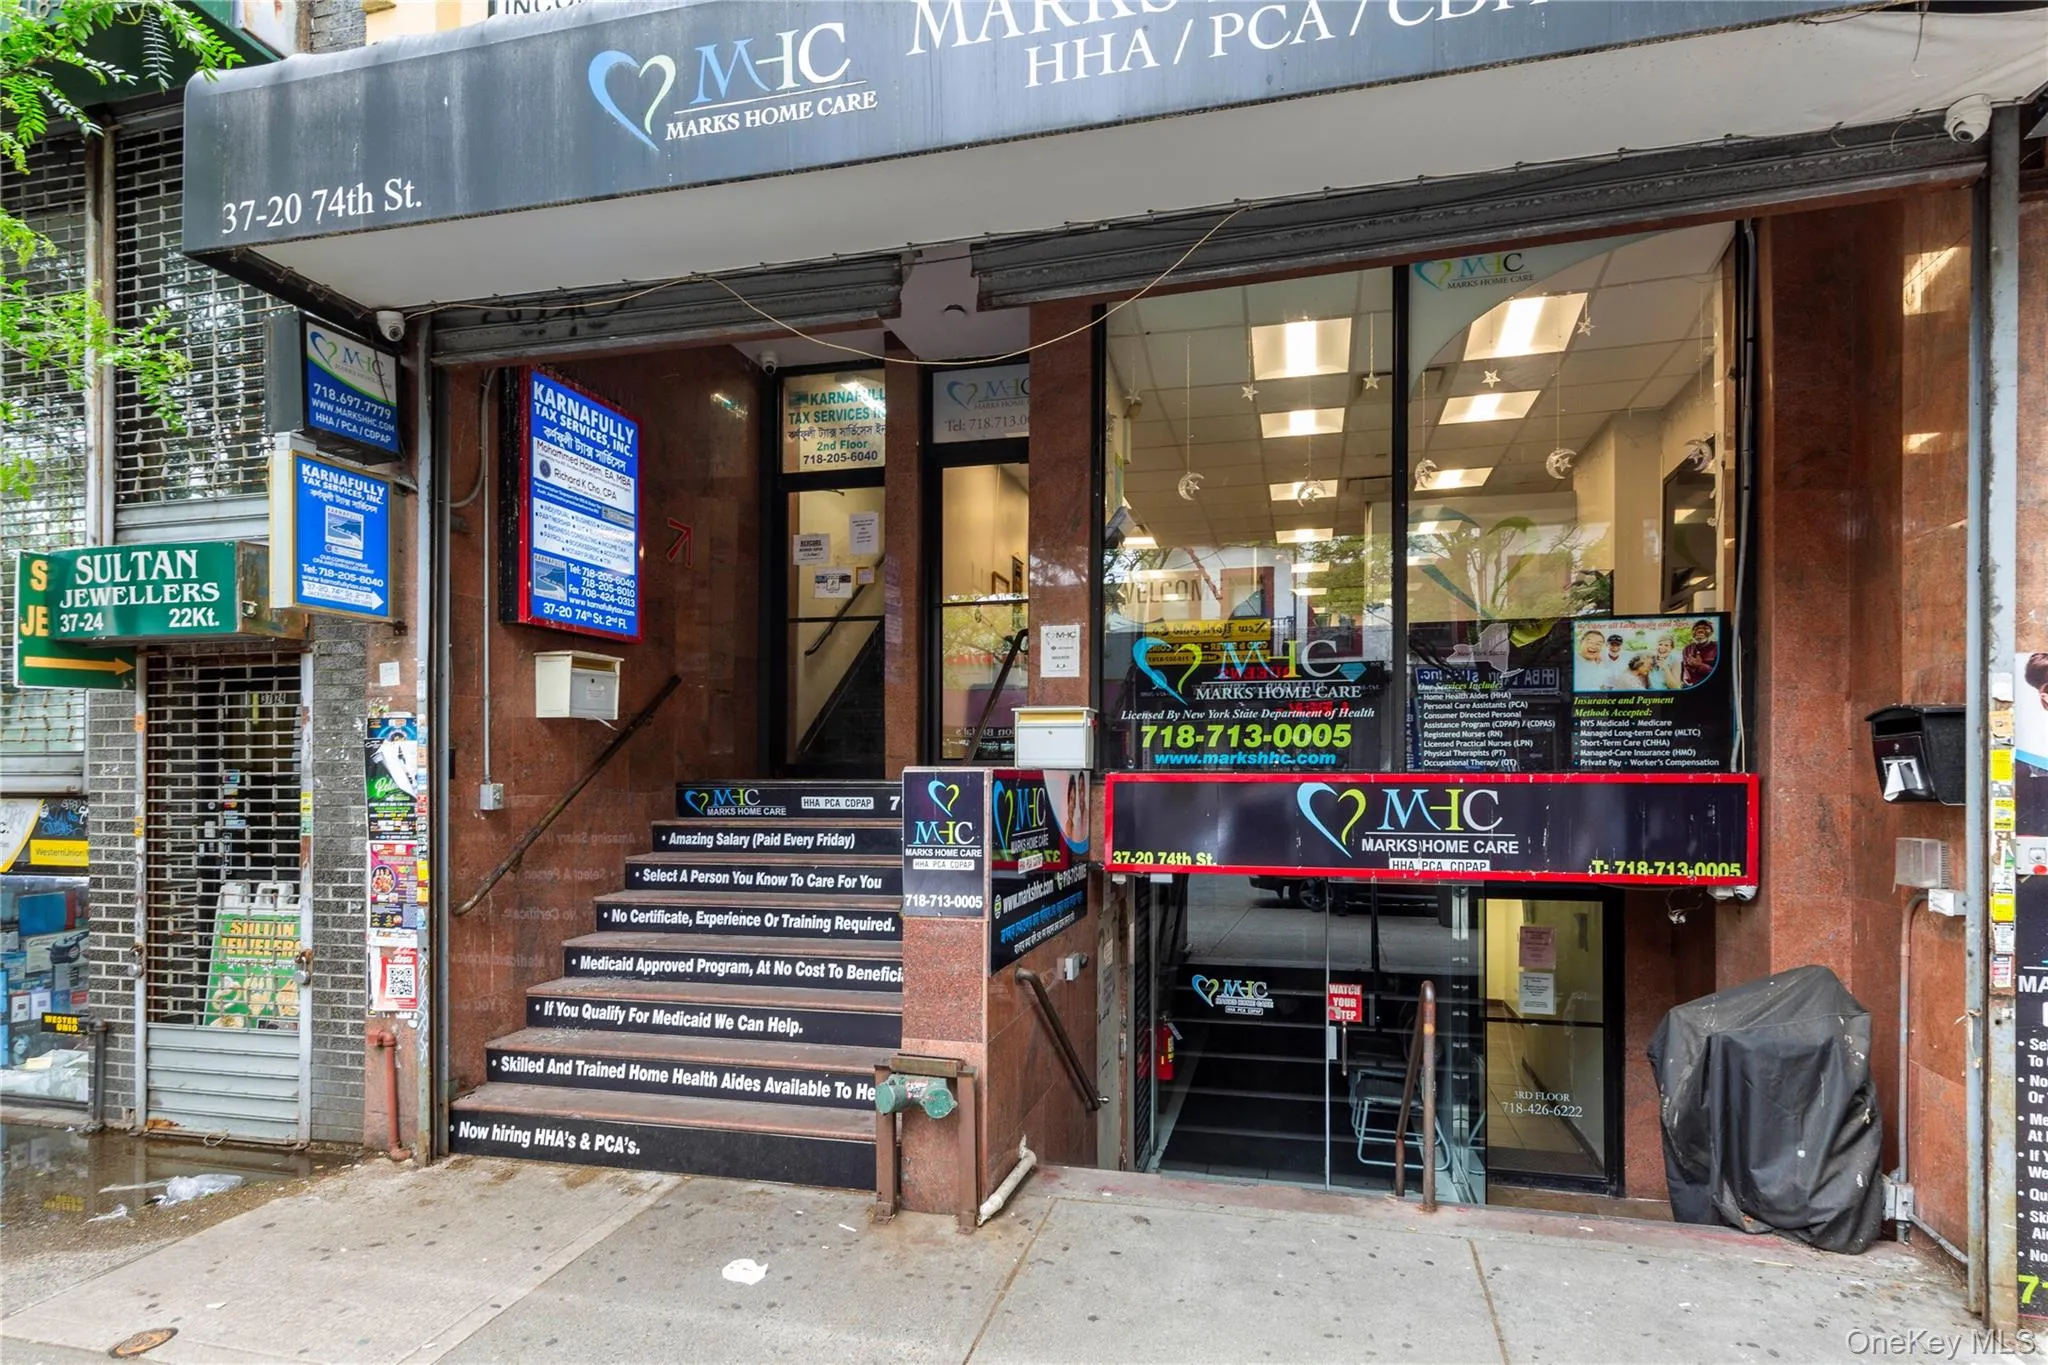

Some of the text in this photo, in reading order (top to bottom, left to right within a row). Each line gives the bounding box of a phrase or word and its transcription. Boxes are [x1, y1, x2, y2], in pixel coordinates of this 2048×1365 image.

[1024, 4, 1335, 88] HHA PCA
[665, 90, 879, 140] MARKS HOME CARE
[221, 179, 423, 236] 37-20 74th St.
[1447, 273, 1535, 289] MARKS HOME CARE
[313, 382, 392, 420] 718.697.7779
[533, 380, 635, 446] KARNAFULLY
[788, 408, 871, 425] TAX SERVICES
[315, 412, 335, 426] HHA
[341, 420, 358, 434] PCA
[534, 401, 633, 458] TAX SERVICES, INC.
[946, 419, 966, 432] Tel:
[816, 439, 868, 452] 2nd Floor
[803, 450, 879, 466] 718-205-6040
[302, 463, 386, 498] KARNAFULLY
[303, 476, 322, 488] TAX
[322, 481, 365, 502] SERVICES,
[366, 493, 385, 506] INC.
[75, 550, 200, 585] SULTAN
[59, 581, 221, 610] JEWELLERS
[543, 602, 572, 618] 37-20
[60, 606, 220, 634] 37-24 22Kt.
[1195, 684, 1362, 701] MARKS HOME CARE
[1573, 695, 1674, 706] Insurance and Payment
[1424, 701, 1528, 710] Personal Care Assistants (PCA)
[1573, 708, 1653, 719] Methods Accepted:
[1121, 706, 1375, 722] Licensed By New York State Department of Health
[1424, 711, 1522, 720] Consumer Directed Personal
[1140, 723, 1352, 749] 718-713-0005
[1424, 740, 1455, 748] Licensed
[1455, 740, 1487, 748] Practical
[1513, 739, 1534, 748] (LPN)
[1154, 751, 1337, 766] www.markshhc.com
[1580, 749, 1697, 758] Managed-Care Insurance (HMO)
[706, 806, 787, 816] MARKS HOME CARE
[803, 798, 873, 809] HHA PCA CDPAP
[1377, 788, 1503, 831] MHC
[669, 831, 855, 850] Amazing Salary (Paid Every Friday)
[1361, 838, 1519, 854] MARKS HOME CARE
[905, 847, 983, 858] MARKS HOME CARE
[1112, 851, 1217, 866] 37-20 74th St.
[914, 859, 973, 871] HHA PCA CDPAP
[1392, 861, 1487, 871] HHA PCA CDPAP
[1591, 860, 1742, 876] T: 718-713-0005
[905, 894, 983, 909] 718-713-0005
[611, 908, 896, 935] No Certificate, Experience Or Training Required.
[579, 955, 844, 979] Medicaid Approved Program, At No Cost To
[1329, 984, 1362, 995] WATCH
[1333, 997, 1357, 1008] YOUR
[543, 1000, 804, 1036] If You Qualify For Medicaid We Can Help.
[1335, 1010, 1357, 1020] STEP
[2027, 1054, 2044, 1067] To
[500, 1055, 852, 1099] Skilled And Trained Home Health Aides Available To
[1514, 1090, 1570, 1102] 3RD FLOOR
[2028, 1091, 2045, 1104] Or
[1502, 1102, 1583, 1118] 718-426-6222
[458, 1120, 641, 1156] Now hiring HHA's & PCA's.
[2028, 1129, 2043, 1142] At
